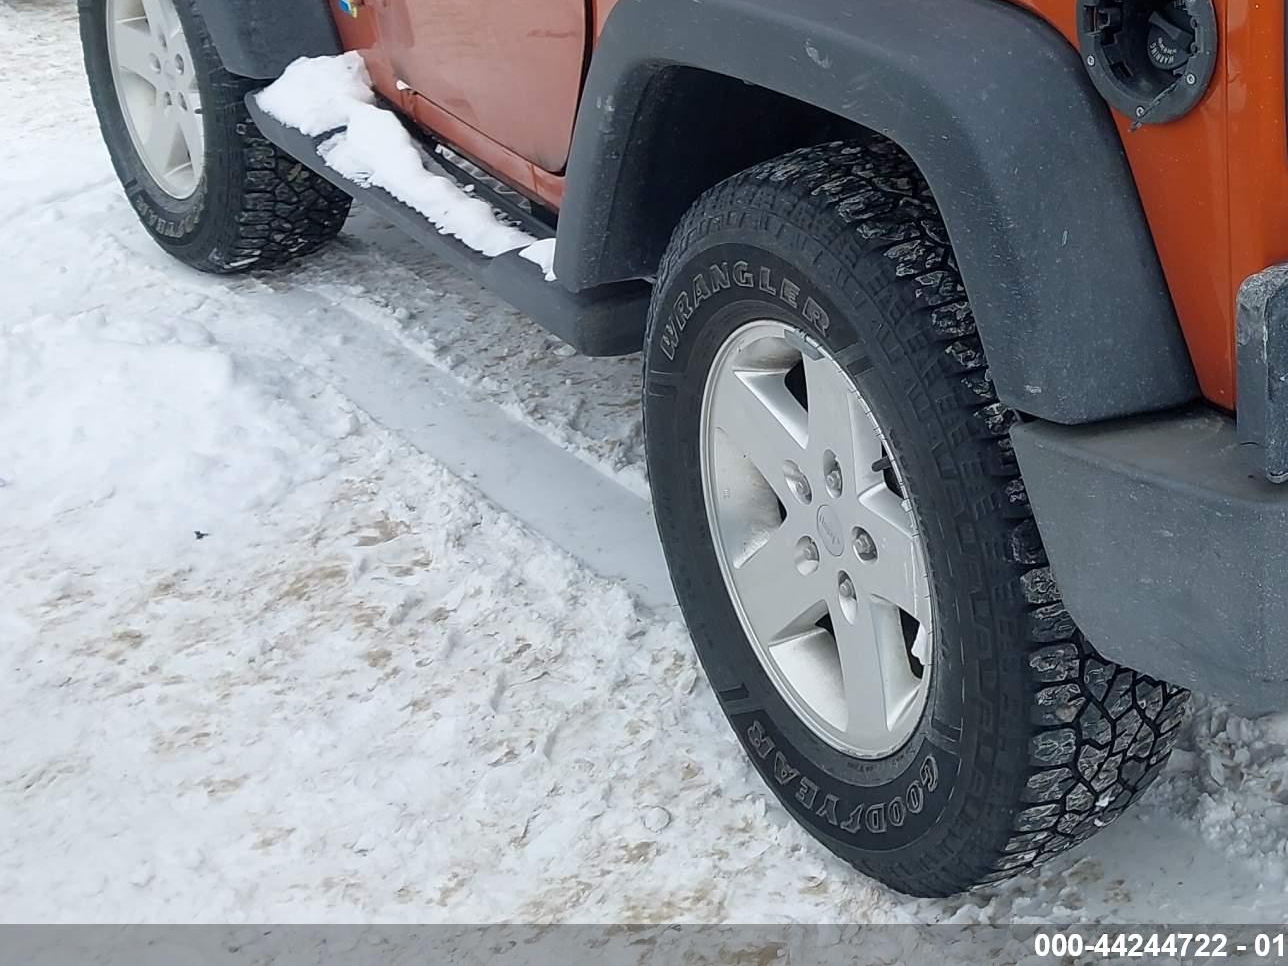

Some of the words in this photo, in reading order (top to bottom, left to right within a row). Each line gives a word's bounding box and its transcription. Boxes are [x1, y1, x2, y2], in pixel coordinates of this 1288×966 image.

[1150, 42, 1174, 64] WARNING
[659, 259, 831, 362] WRANGLER
[747, 720, 939, 834] GOODYEAR
